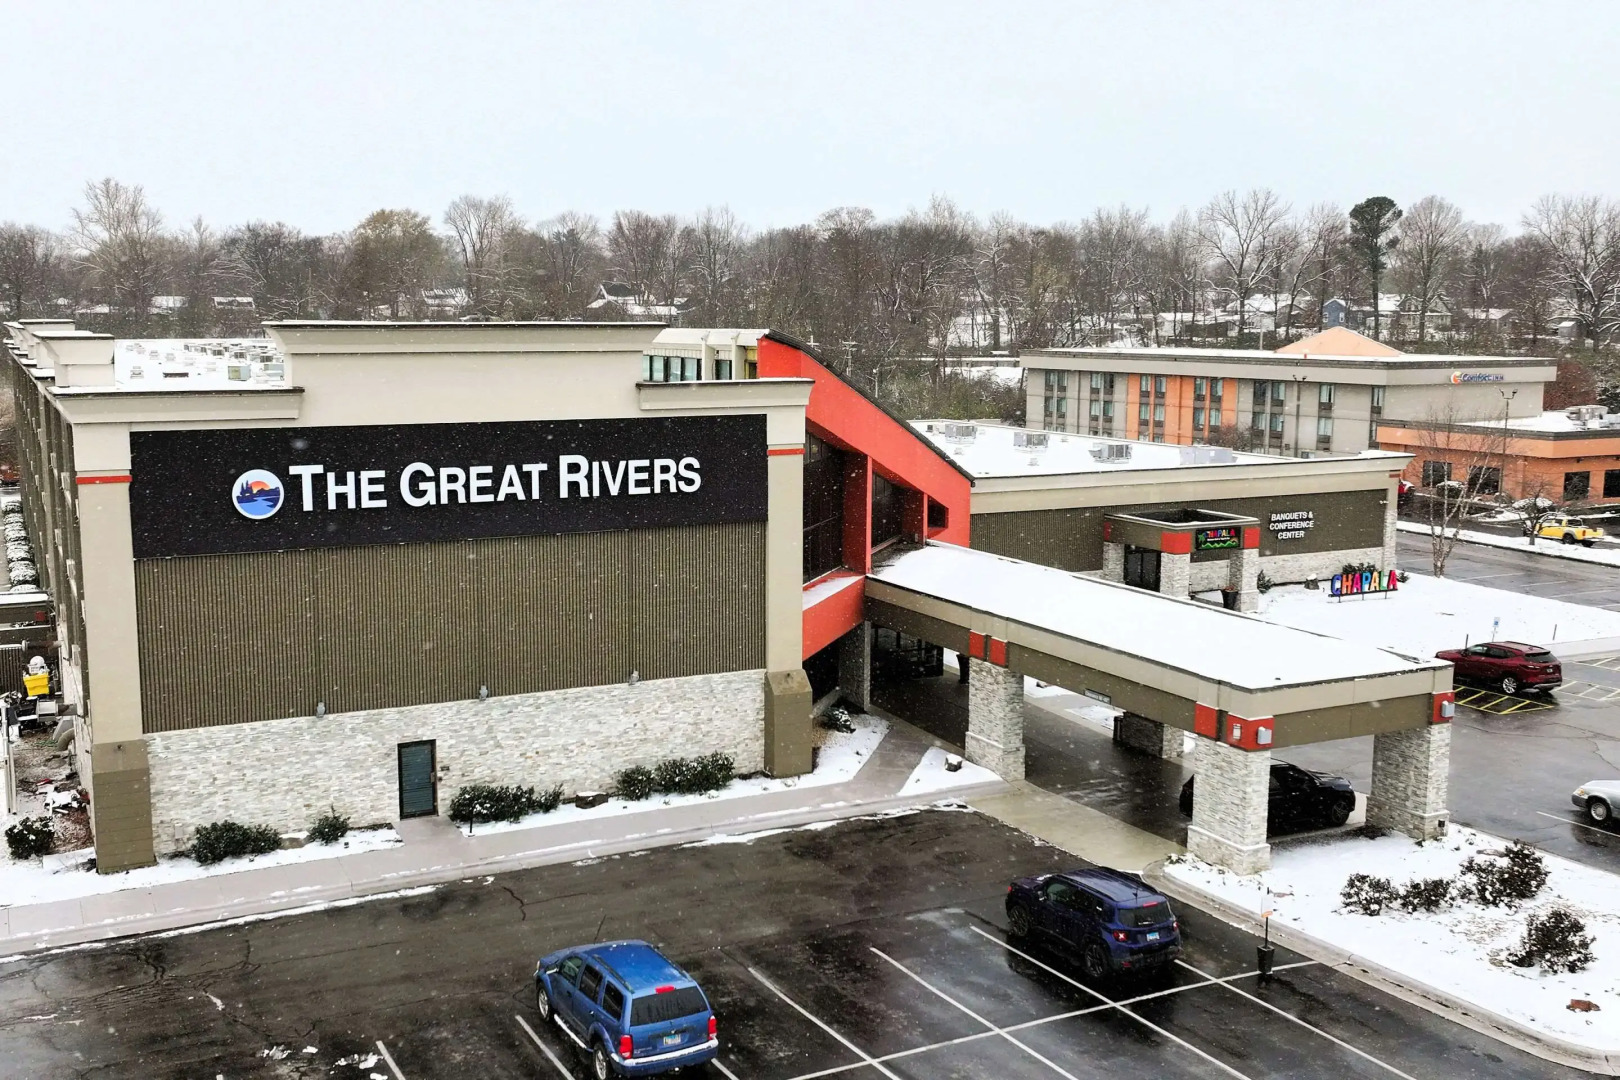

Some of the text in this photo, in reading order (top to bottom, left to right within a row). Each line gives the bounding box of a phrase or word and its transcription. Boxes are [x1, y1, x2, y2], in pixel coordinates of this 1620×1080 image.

[288, 454, 701, 512] THE GREAT RIVERS
[1271, 511, 1314, 521] BANQUETS &
[1269, 520, 1314, 530] CONFERENCE
[1204, 528, 1236, 538] CHAPALA
[1278, 530, 1305, 539] CENTER
[1331, 569, 1398, 596] CHAPALA
